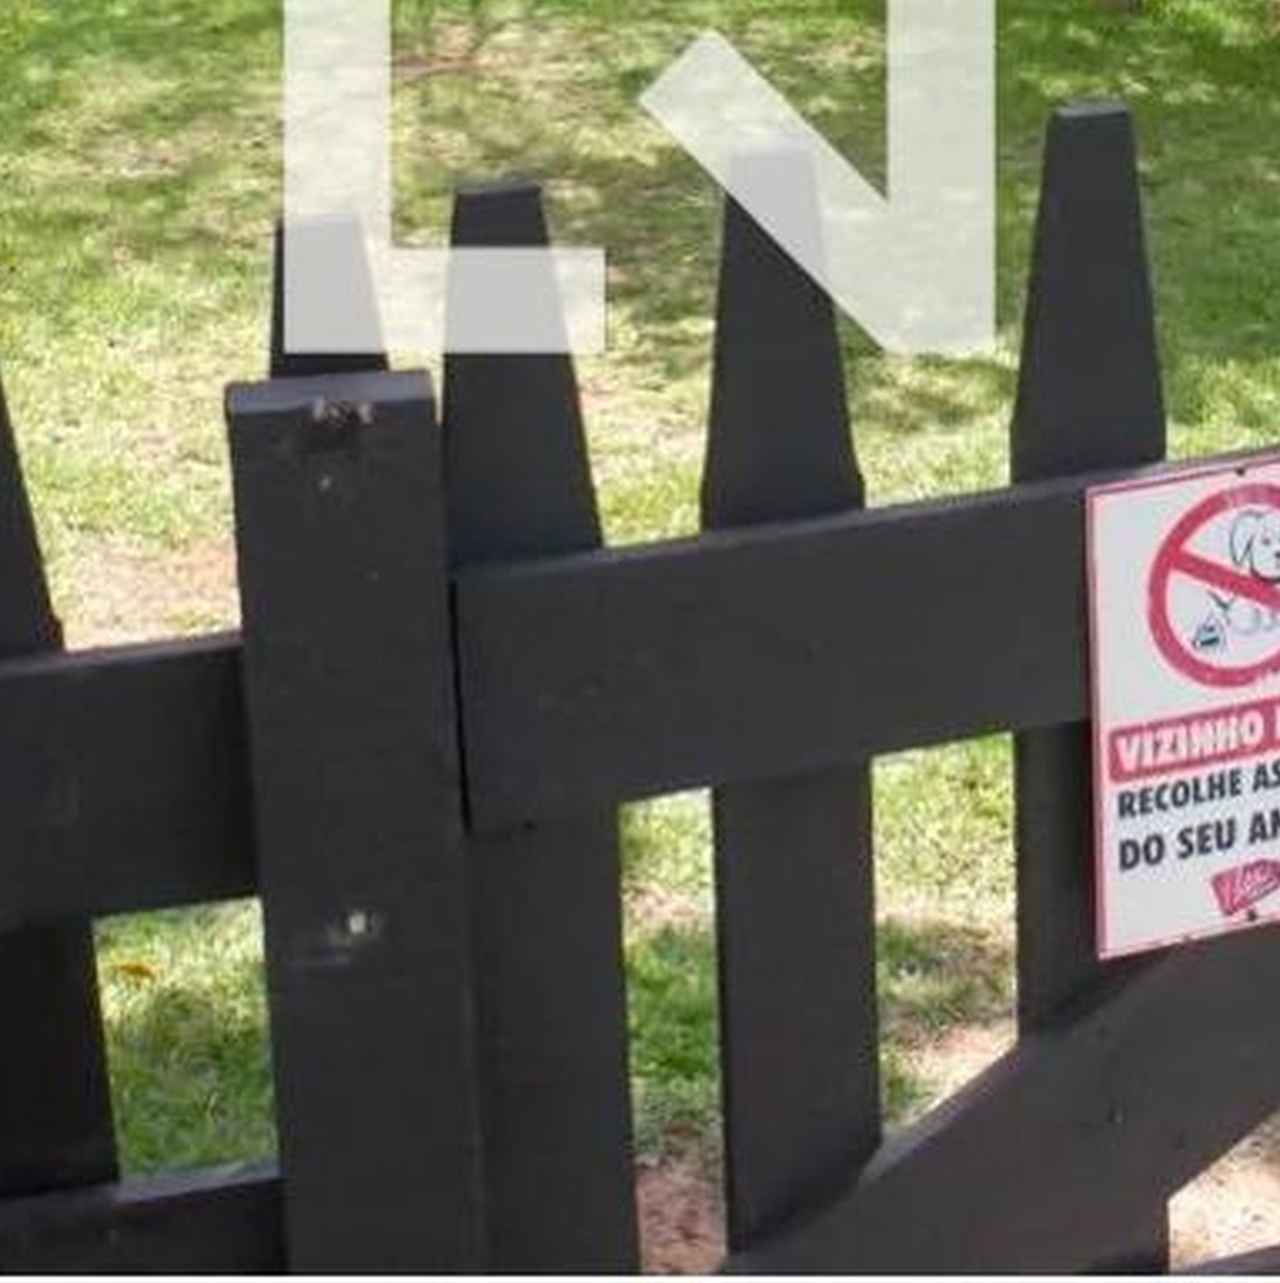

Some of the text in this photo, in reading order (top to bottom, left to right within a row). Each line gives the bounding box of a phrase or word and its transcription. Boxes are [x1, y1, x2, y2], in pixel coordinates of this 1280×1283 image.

[1116, 709, 1264, 770] VIZINHO
[1117, 768, 1242, 819] RECOLHE
[1118, 833, 1166, 871] DO
[1176, 818, 1237, 860] SEU
